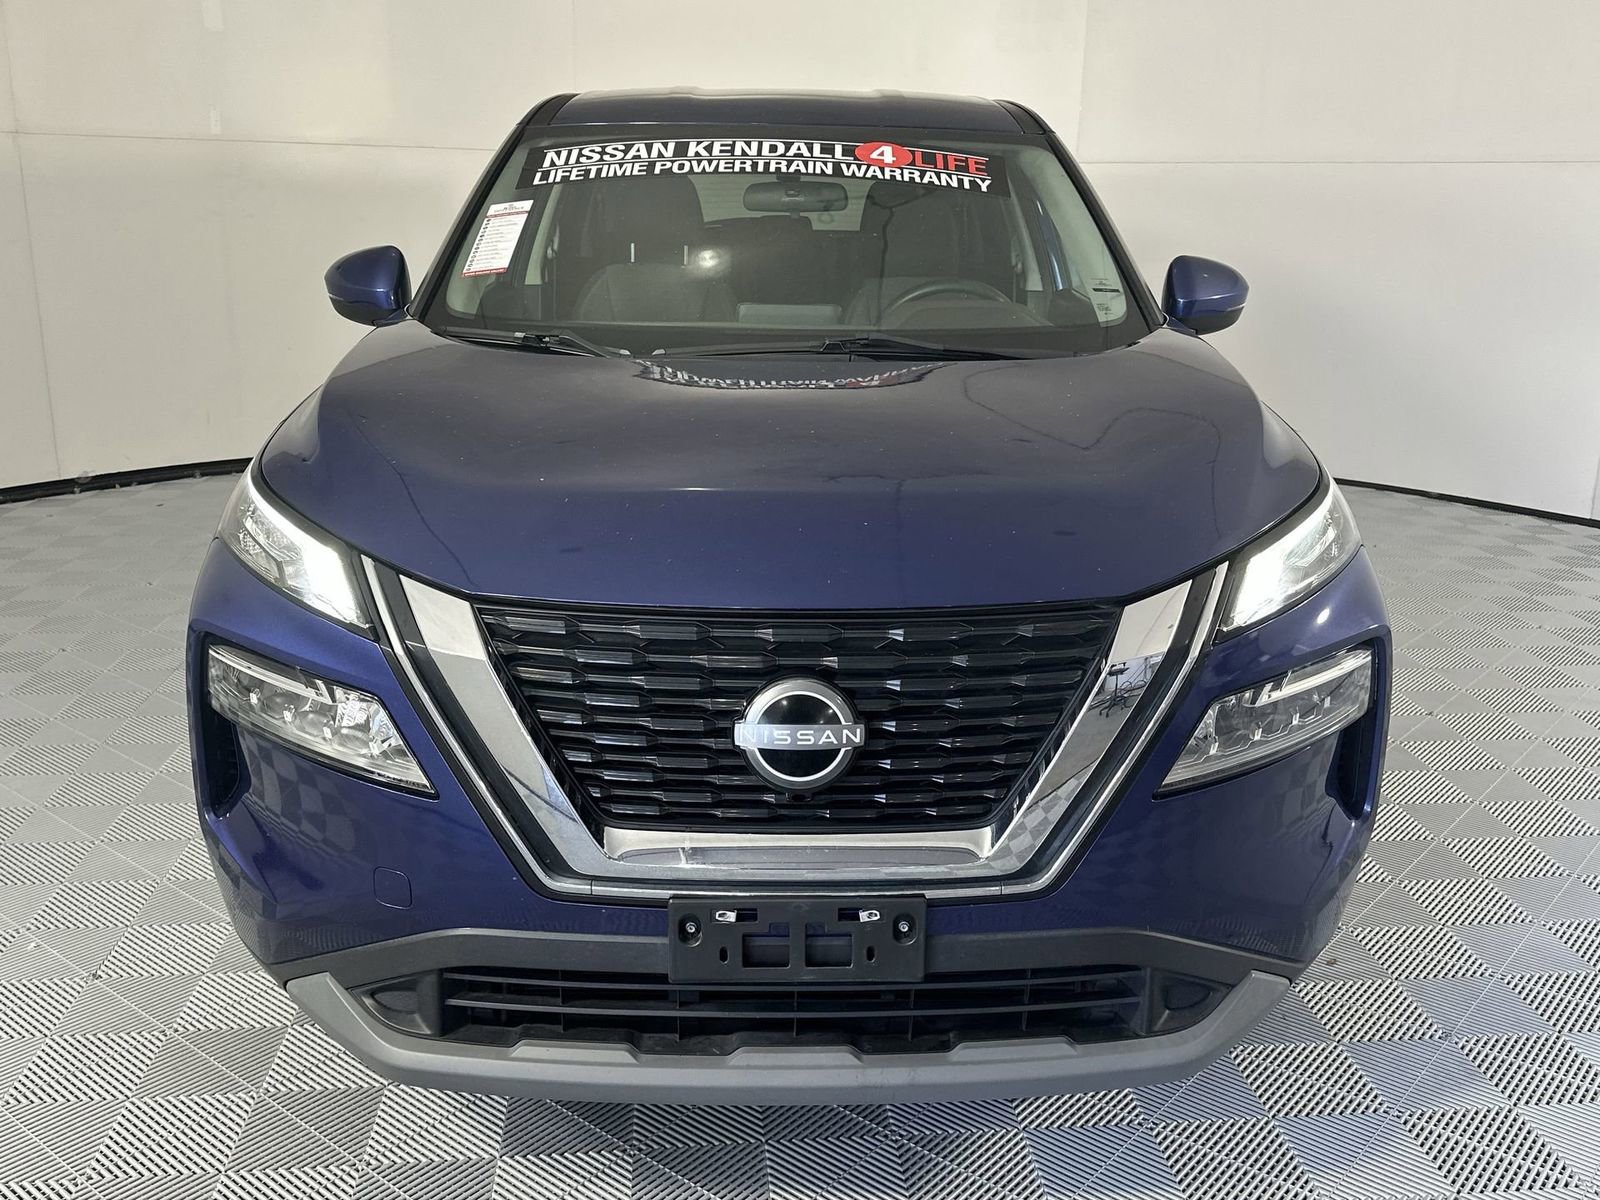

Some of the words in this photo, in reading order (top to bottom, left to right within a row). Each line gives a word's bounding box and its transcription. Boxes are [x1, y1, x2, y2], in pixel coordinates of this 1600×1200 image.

[542, 141, 675, 168] NISSAN
[687, 141, 854, 161] KENDALL
[869, 145, 897, 164] 4
[914, 152, 988, 176] LIFE
[532, 161, 647, 185] LIFETIME
[653, 159, 833, 175] POWERTRAIN
[840, 163, 992, 193] WARRANTY
[739, 728, 861, 745] NISSAN
